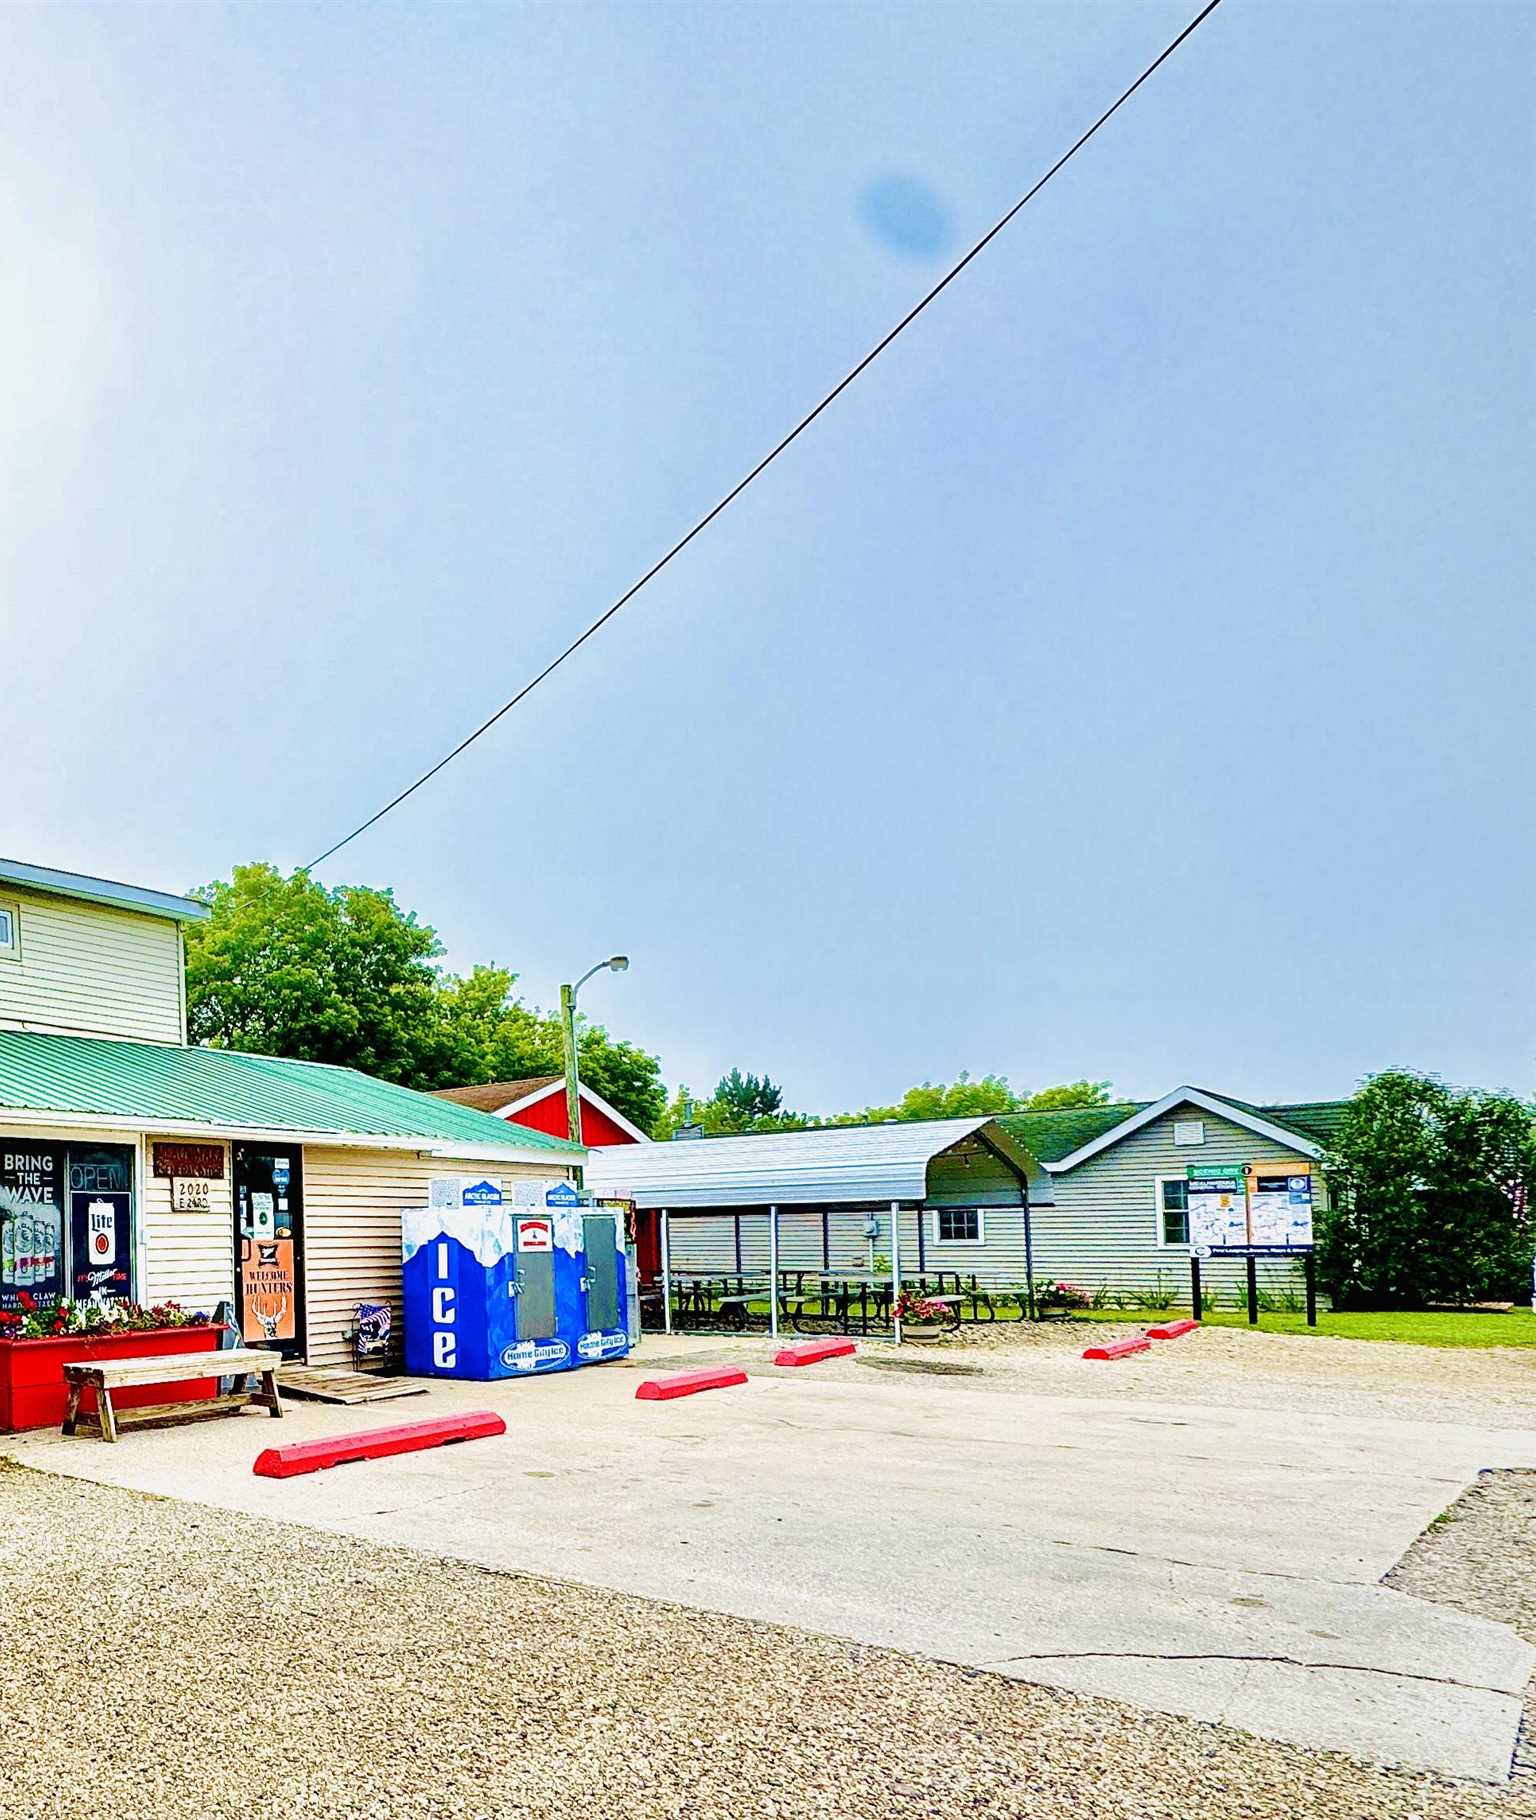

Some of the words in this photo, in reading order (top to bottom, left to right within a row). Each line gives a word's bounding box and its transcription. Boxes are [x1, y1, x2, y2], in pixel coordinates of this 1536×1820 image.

[4, 1154, 53, 1171] BRING
[17, 1173, 41, 1185] THE
[70, 1166, 121, 1189] OPEN
[5, 1187, 54, 1204] WAVE
[179, 1183, 209, 1195] 2020
[91, 1213, 113, 1232] Lite
[249, 1271, 289, 1281] WELCOME
[245, 1282, 293, 1296] HUNTERS
[33, 1292, 57, 1301] CLAW
